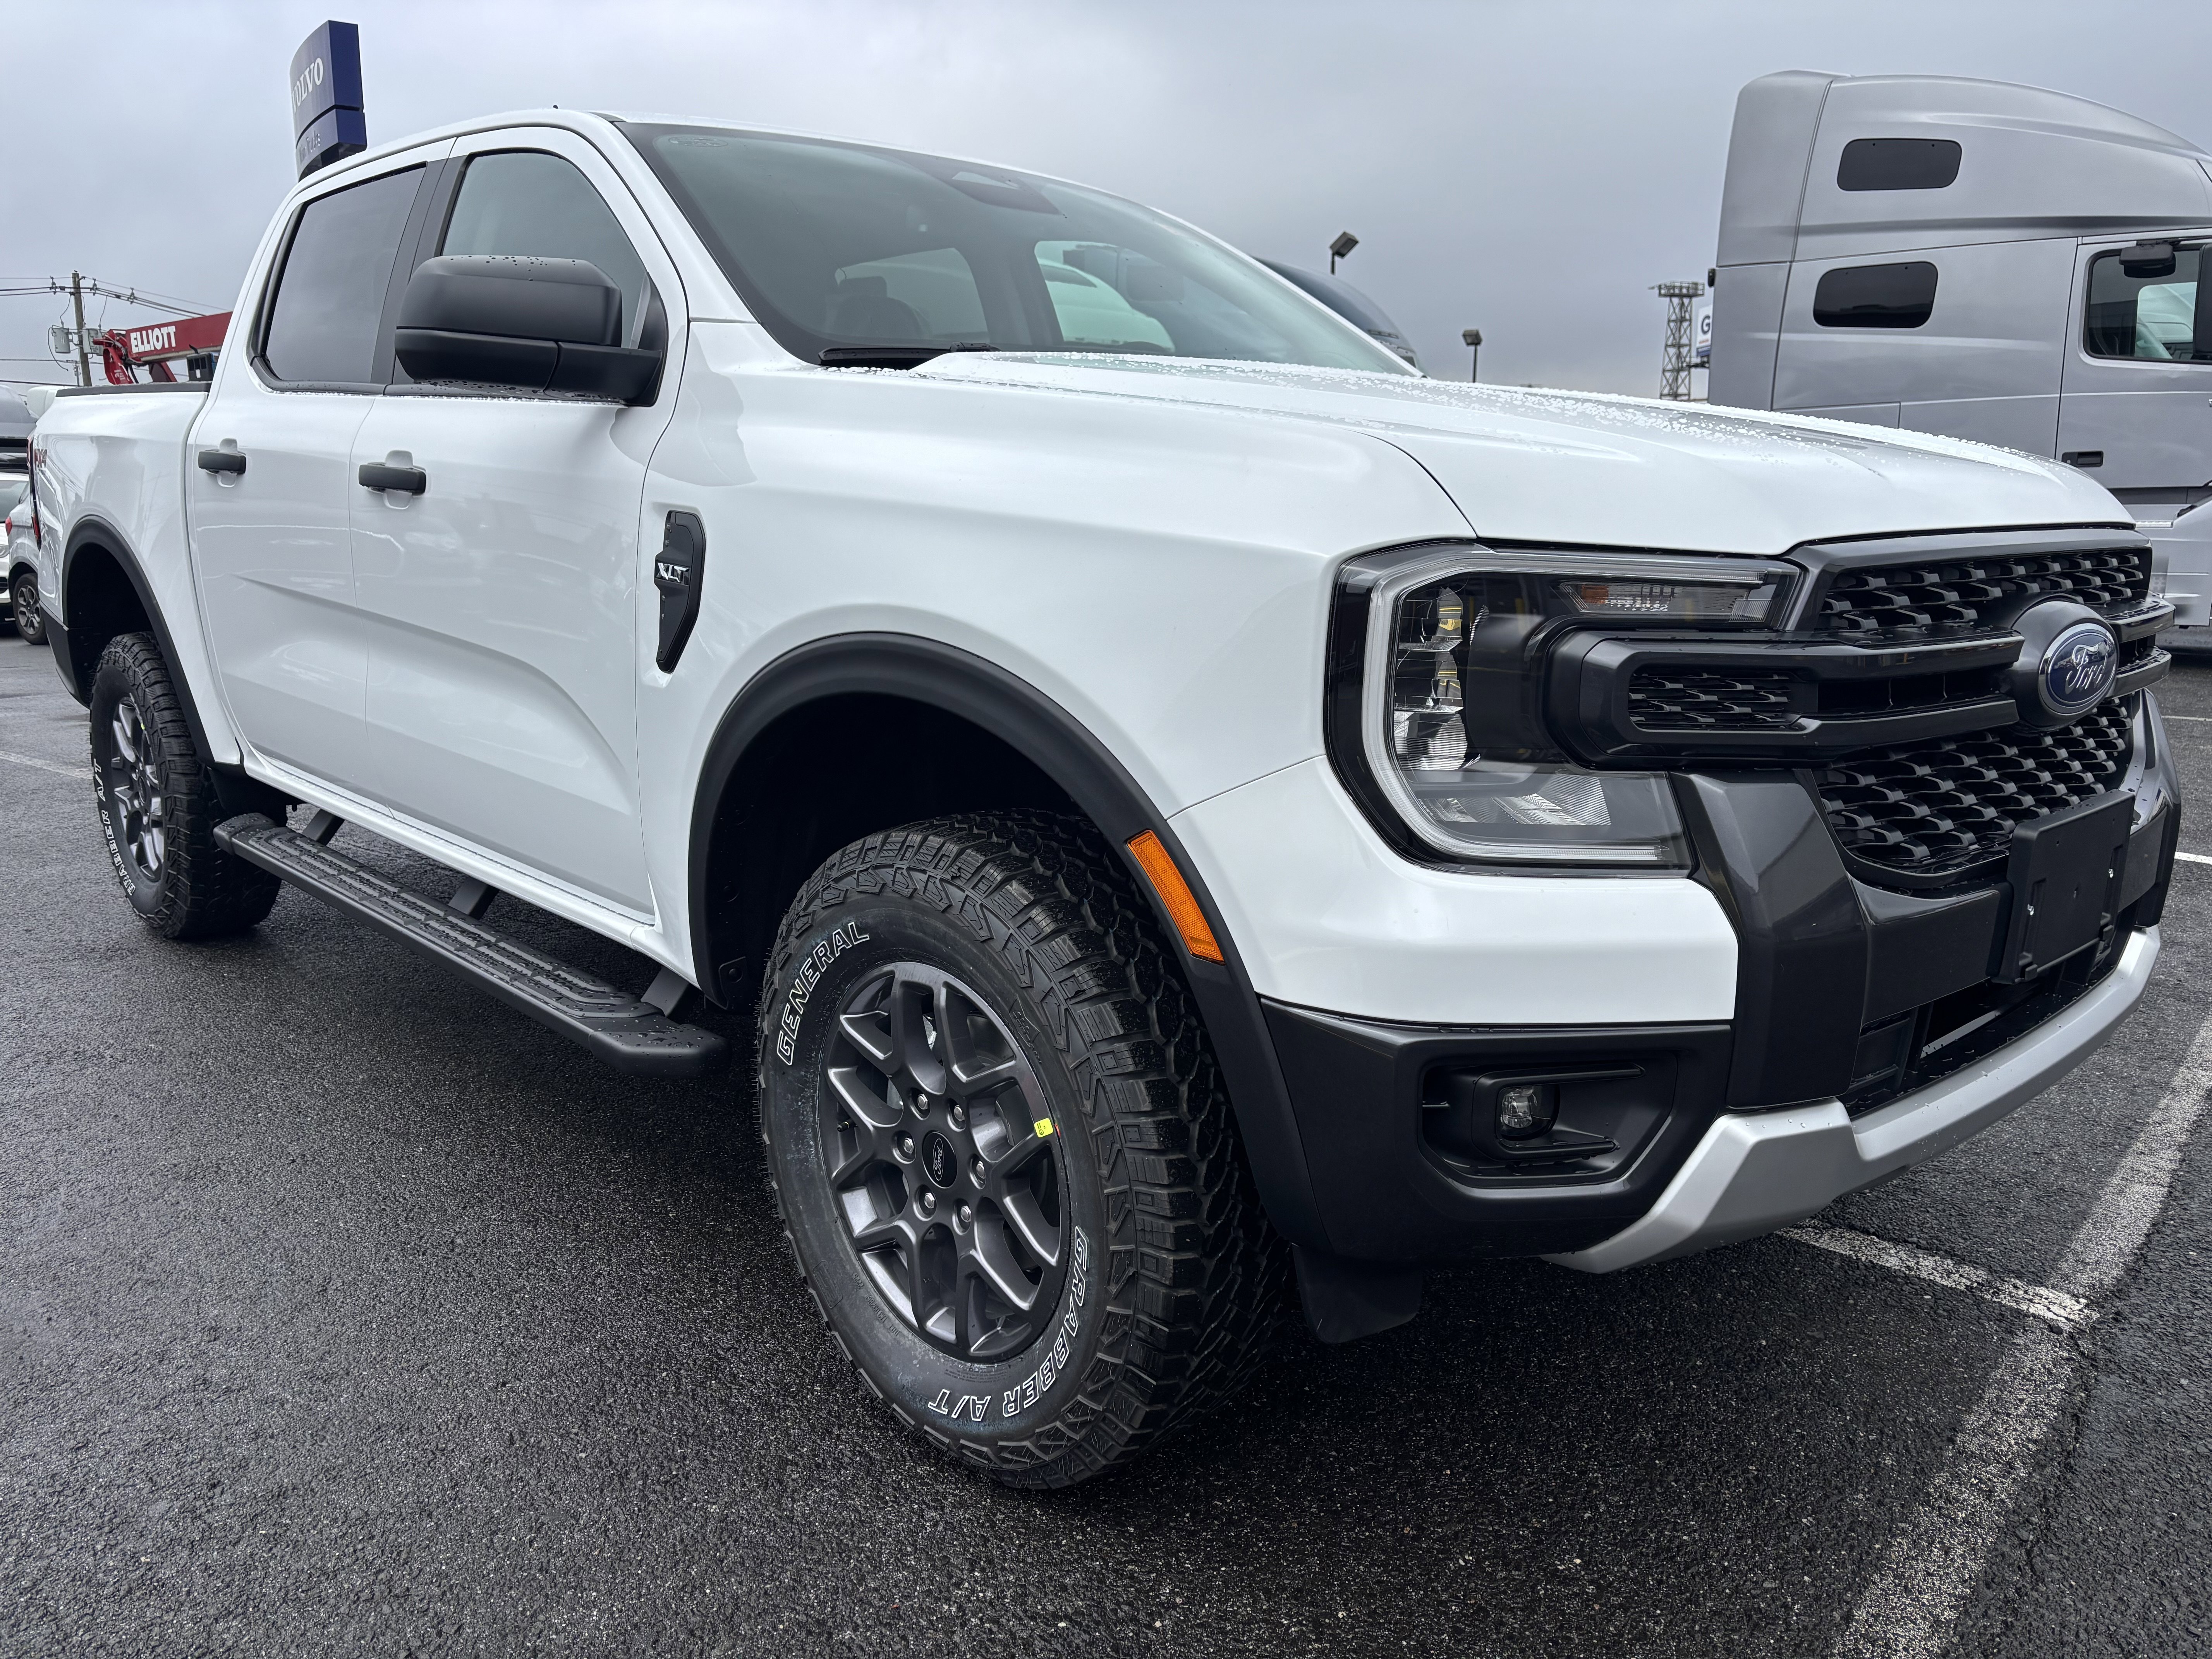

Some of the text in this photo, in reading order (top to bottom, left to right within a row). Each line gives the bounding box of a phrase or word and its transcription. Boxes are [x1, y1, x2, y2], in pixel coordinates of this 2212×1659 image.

[292, 58, 323, 115] VOLVO
[130, 326, 176, 353] ELLIOTT
[656, 562, 689, 584] XLT
[2065, 644, 2109, 694] Ford
[94, 758, 136, 896] GRABBER A/T
[776, 922, 870, 1066] GENERAL
[934, 1145, 943, 1175] Ford
[927, 1226, 1089, 1422] GRABBER A/T
